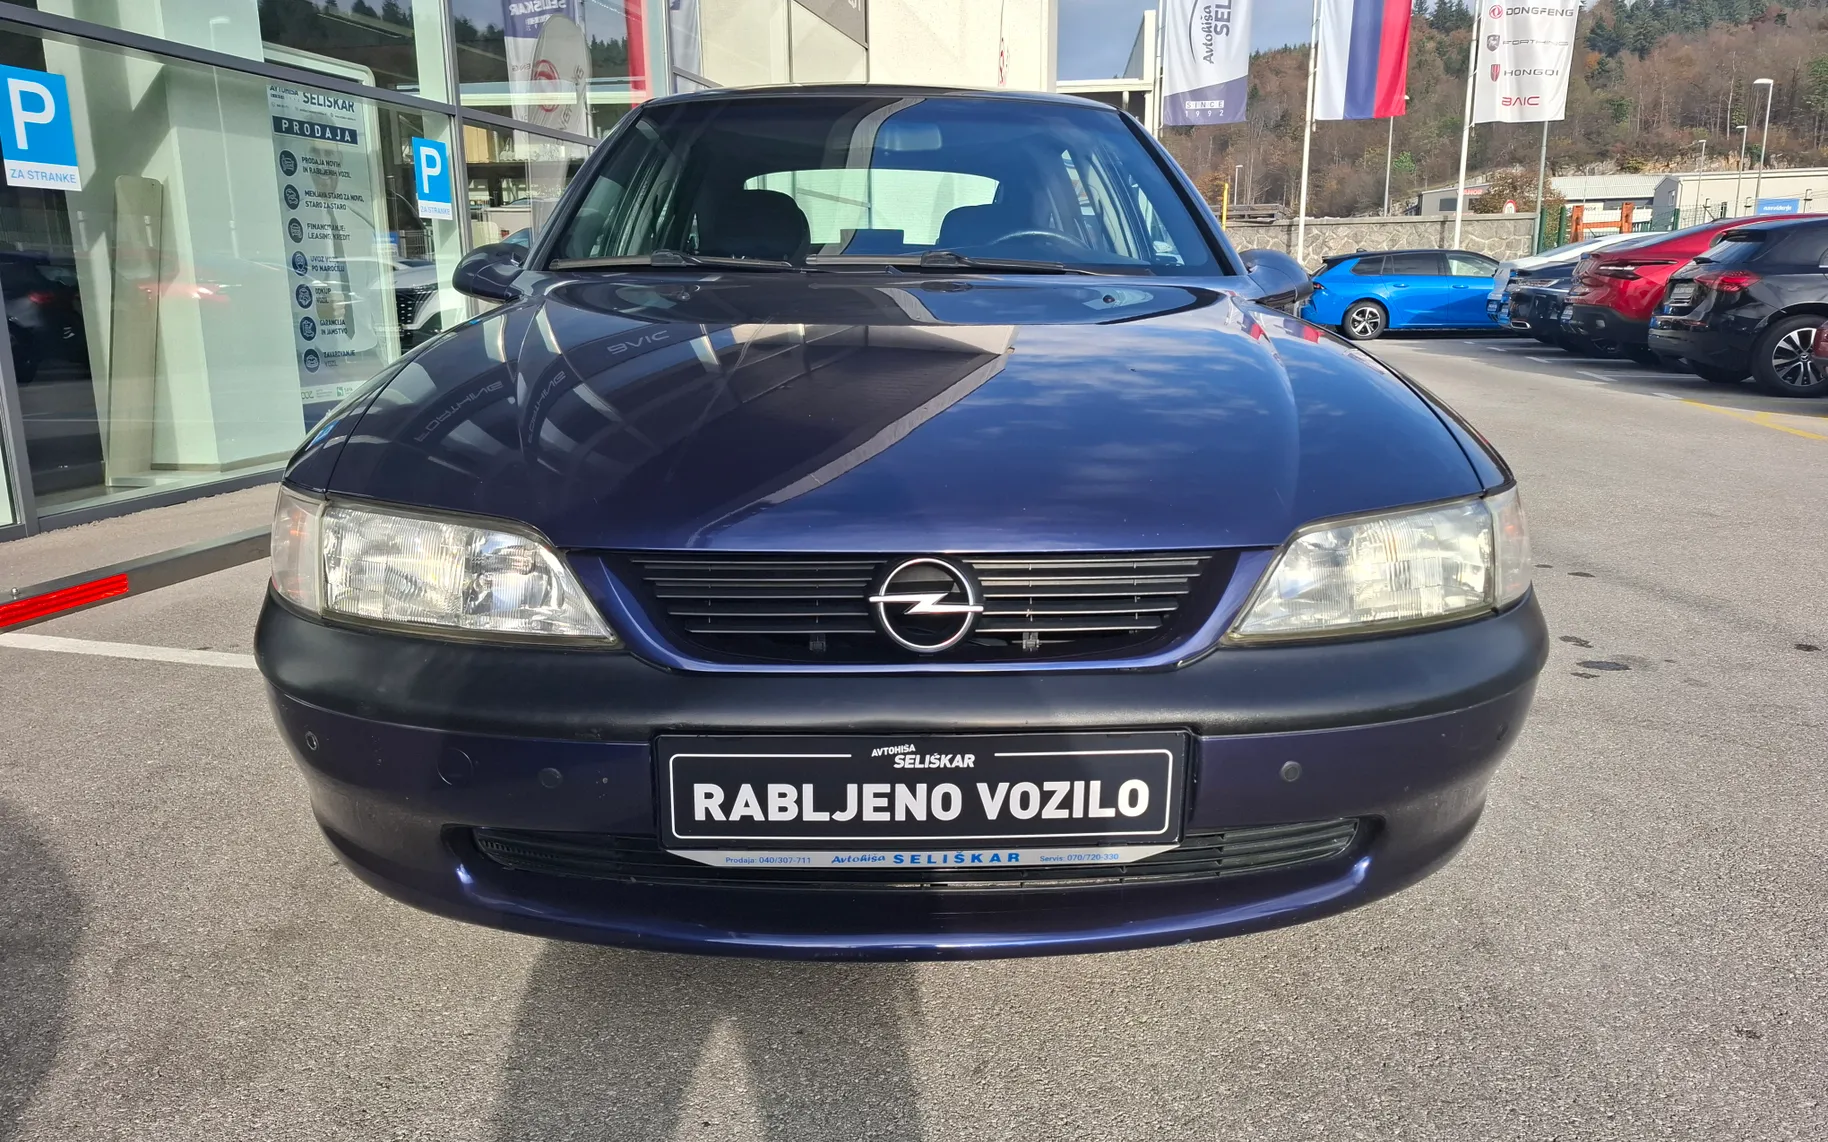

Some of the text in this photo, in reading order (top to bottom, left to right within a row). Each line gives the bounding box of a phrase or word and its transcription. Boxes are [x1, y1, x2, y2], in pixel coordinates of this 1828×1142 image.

[1505, 7, 1574, 16] DONGFENG
[1201, 5, 1214, 64] Avtohiša
[1504, 69, 1559, 77] HONGQI
[1501, 96, 1540, 106] BAIC
[7, 77, 56, 150] P
[281, 119, 352, 142] PRODAJA
[302, 156, 341, 168] PRODAJA NOVIH
[9, 168, 77, 184] ZA STRANKE
[309, 167, 337, 177] RABLJENIH
[338, 170, 352, 179] VOZIL
[420, 146, 442, 194] P
[304, 190, 327, 199] MENJAVA
[327, 192, 343, 200] STARO
[305, 200, 322, 208] STARO
[428, 206, 450, 215] STRANKE
[333, 233, 350, 241] KREDIT
[871, 744, 916, 757] AVTOHIŠA
[893, 753, 975, 768] SELIŠKAR
[694, 779, 1149, 821] RABLJENO VOZILO
[725, 856, 811, 864] Prodaja: 040/307-711
[831, 850, 1020, 864] Avtohiša SELIŠKAR
[1067, 853, 1119, 861] 070/720-330
